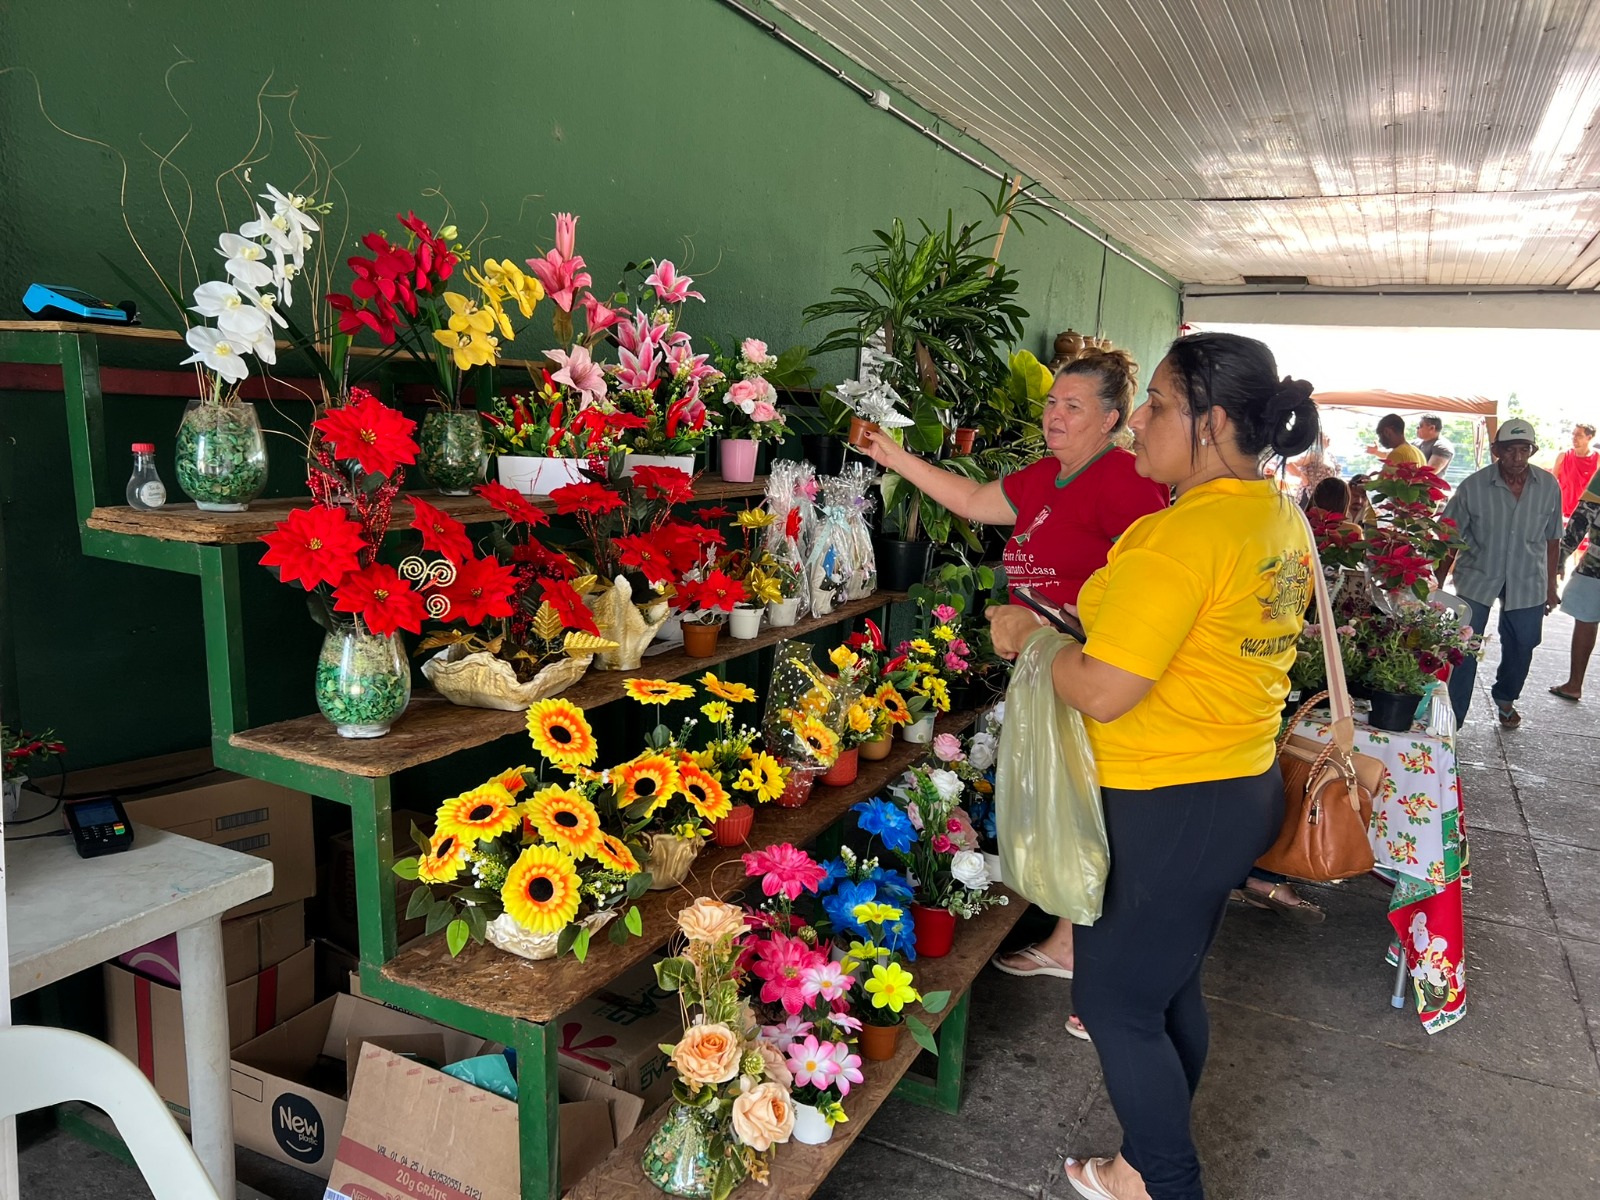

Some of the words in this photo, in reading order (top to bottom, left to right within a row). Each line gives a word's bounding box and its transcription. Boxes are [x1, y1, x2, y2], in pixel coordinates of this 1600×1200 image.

[1028, 553, 1034, 562] e
[1025, 562, 1056, 575] Ceasa
[279, 1105, 319, 1138] New
[298, 1133, 319, 1146] plastic
[377, 1144, 387, 1157] VAL
[410, 1160, 419, 1172] 25
[395, 1169, 415, 1191] 20g
[416, 1180, 448, 1200] GRÁTIS
